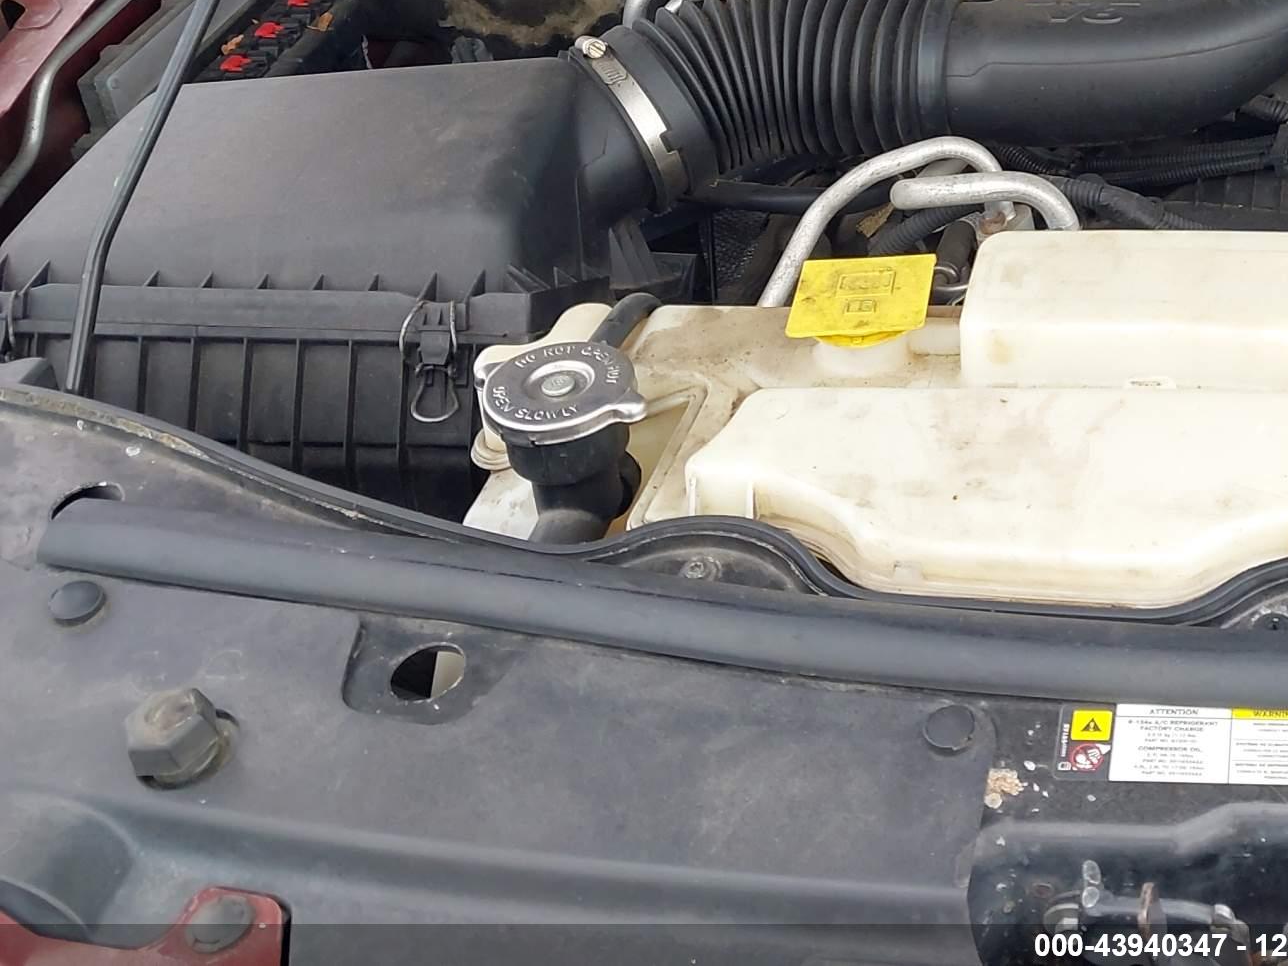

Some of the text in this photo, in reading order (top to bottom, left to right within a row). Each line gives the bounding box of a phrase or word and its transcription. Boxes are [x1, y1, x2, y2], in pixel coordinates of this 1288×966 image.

[514, 353, 537, 369] DO
[514, 403, 579, 421] SLOWLY
[1149, 708, 1200, 716] ATTENTION
